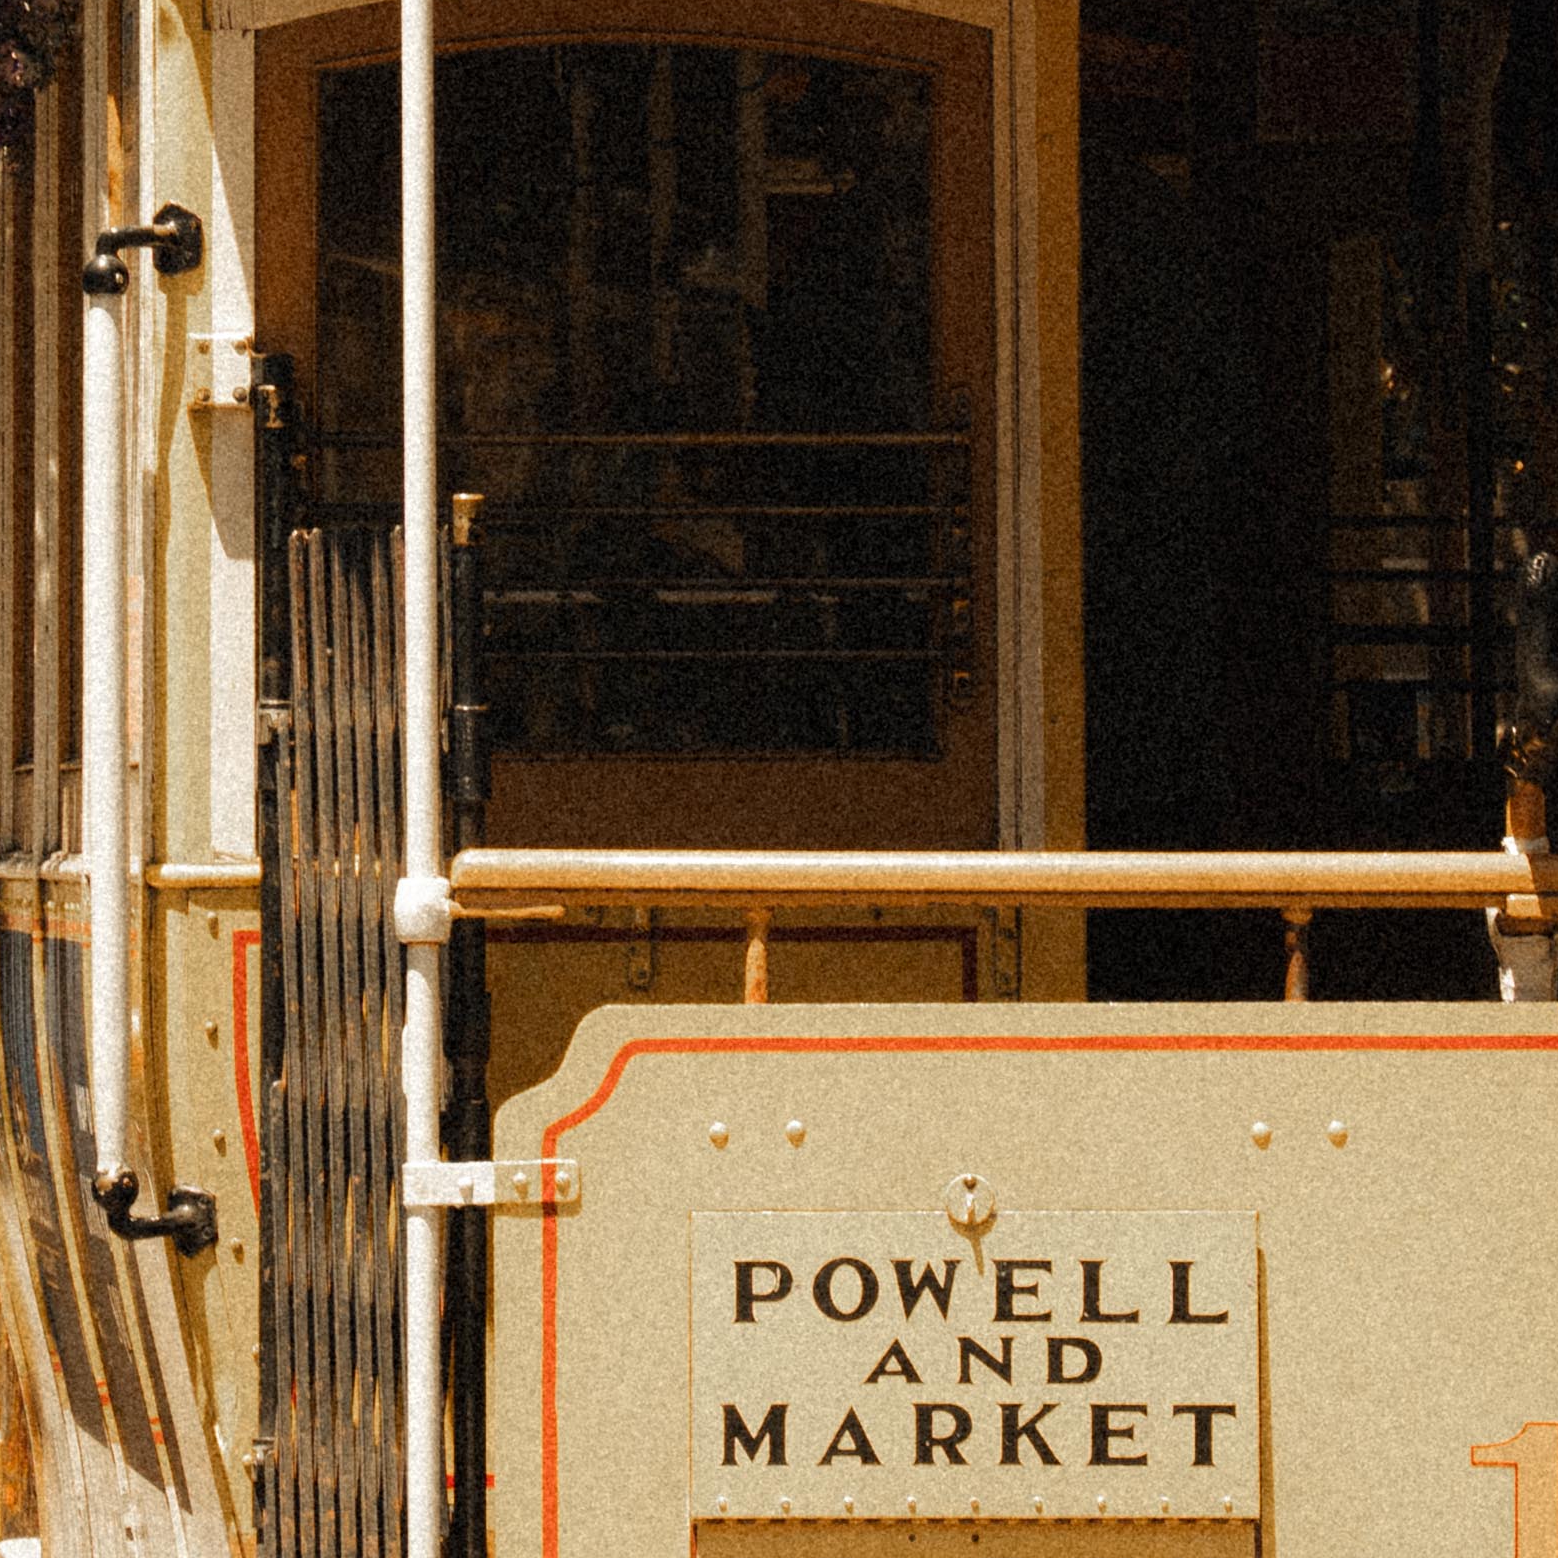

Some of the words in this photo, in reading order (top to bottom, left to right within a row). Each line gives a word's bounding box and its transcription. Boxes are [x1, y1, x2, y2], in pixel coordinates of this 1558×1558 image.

[733, 1257, 1229, 1325] POWELL
[865, 1336, 1104, 1385] AND
[722, 1403, 1237, 1467] MARKET
